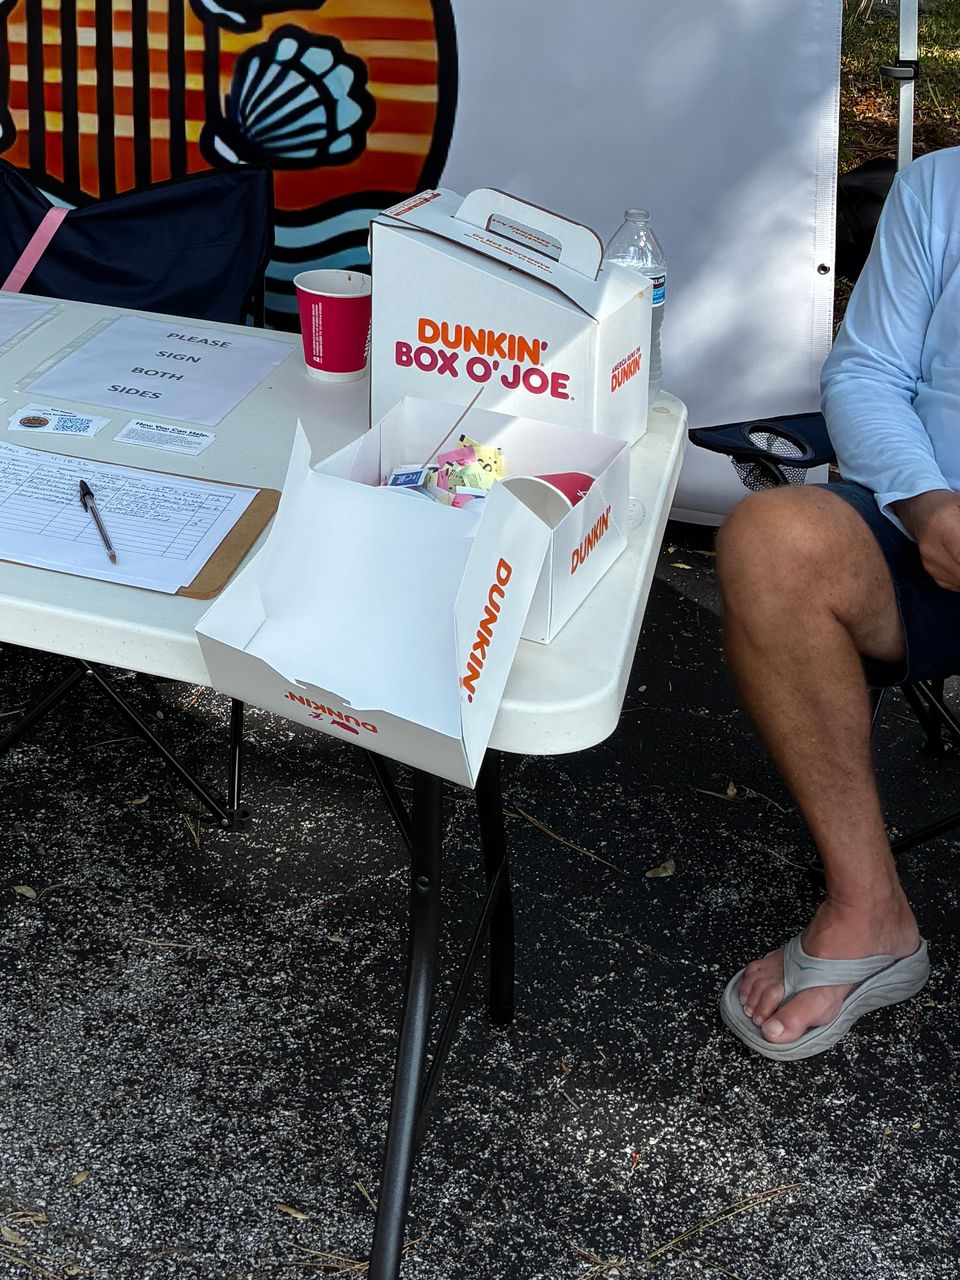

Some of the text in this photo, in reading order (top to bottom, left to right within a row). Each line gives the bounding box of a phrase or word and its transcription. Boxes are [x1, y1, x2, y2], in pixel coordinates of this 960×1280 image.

[166, 331, 232, 349] PLEASE
[417, 316, 548, 368] DUNKIN'
[155, 349, 202, 365] SIGN
[394, 340, 460, 381] BOX
[131, 365, 185, 382] BOTH
[107, 383, 163, 401] SIDES
[135, 421, 153, 429] How
[569, 505, 612, 576] DUNKIN'
[460, 556, 513, 705] DUNKIN'
[283, 690, 379, 734] DUNKIN'
